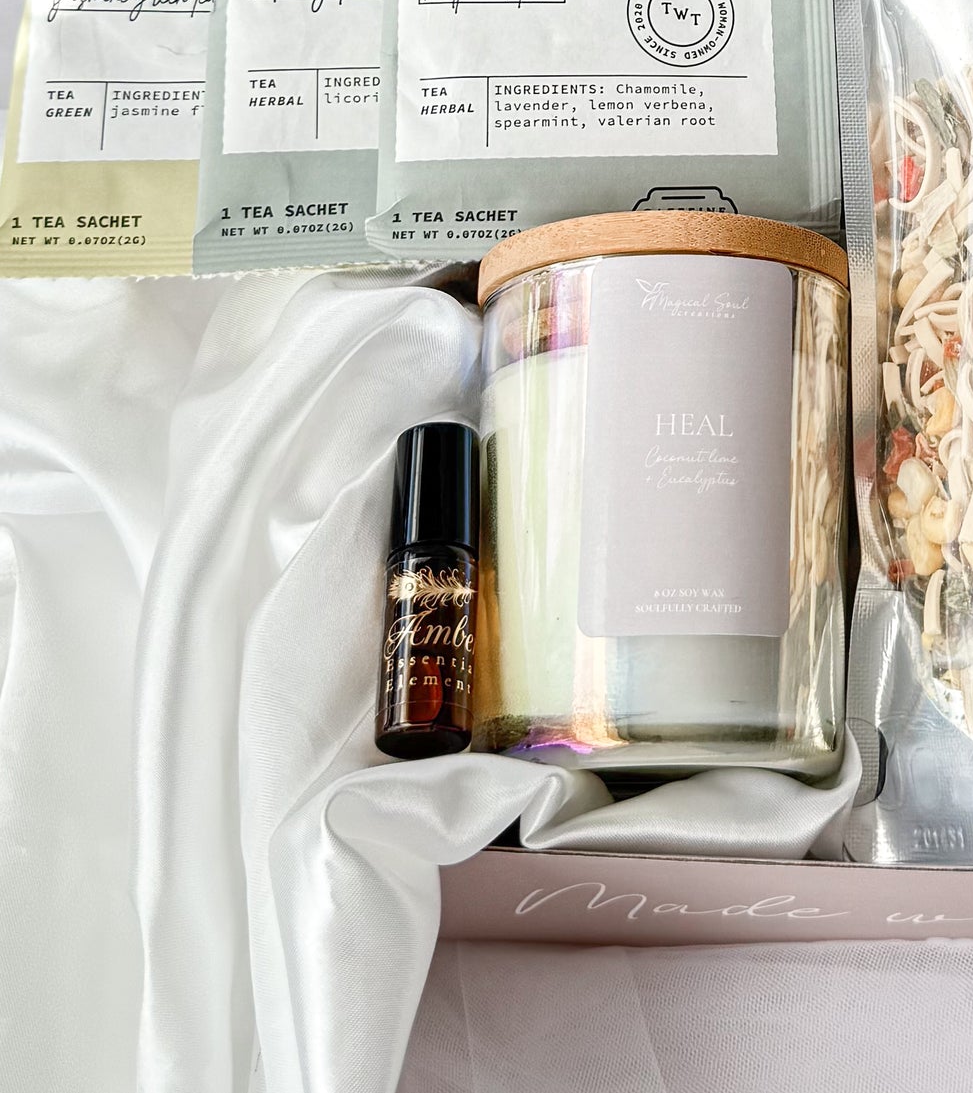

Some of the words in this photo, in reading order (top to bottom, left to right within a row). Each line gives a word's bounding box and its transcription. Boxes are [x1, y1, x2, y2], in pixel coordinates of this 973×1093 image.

[634, 3, 646, 31] 2020
[683, 1, 727, 60] WOMAN-OWNED
[644, 35, 677, 59] SINCE
[250, 79, 276, 89] TEA
[495, 83, 605, 96] INGREDIENTS:
[616, 83, 705, 97] Chamomile,
[48, 90, 74, 100] TEA
[421, 87, 447, 97] TEA
[249, 95, 304, 107] HERBAL
[494, 99, 578, 113] lavender,
[589, 99, 634, 111] lemon
[643, 99, 715, 113] verbena,
[45, 107, 93, 118] GREEN
[110, 105, 179, 119] jasmine
[420, 103, 475, 115] HERBAL
[494, 115, 587, 130] spearmint,
[598, 114, 671, 127] valerian
[680, 116, 716, 127] root
[221, 207, 231, 220] 1
[241, 206, 276, 219] TEA
[285, 203, 348, 217] SACHET
[392, 212, 403, 223] 1
[411, 211, 444, 223] TEA
[455, 210, 518, 223] SACHET
[11, 217, 22, 229] 1
[32, 216, 65, 229] TEA
[77, 215, 143, 229] SACHET
[221, 227, 244, 237] NET
[253, 226, 269, 236] WT
[392, 230, 415, 240] NET
[423, 230, 438, 240] WT
[12, 236, 35, 246] NET
[44, 236, 59, 246] WT
[653, 290, 710, 316] Magical
[714, 292, 750, 312] Soul
[656, 414, 733, 437] HEAL
[645, 445, 710, 468] Coconut
[656, 466, 738, 494] Eucalyptus
[661, 588, 676, 597] OZ
[678, 588, 699, 597] SOY
[701, 588, 725, 598] WAX
[635, 603, 694, 613] SOULFULLY
[696, 604, 742, 614] CRAFTED
[384, 608, 474, 660] Ambe
[515, 882, 849, 920] Made
